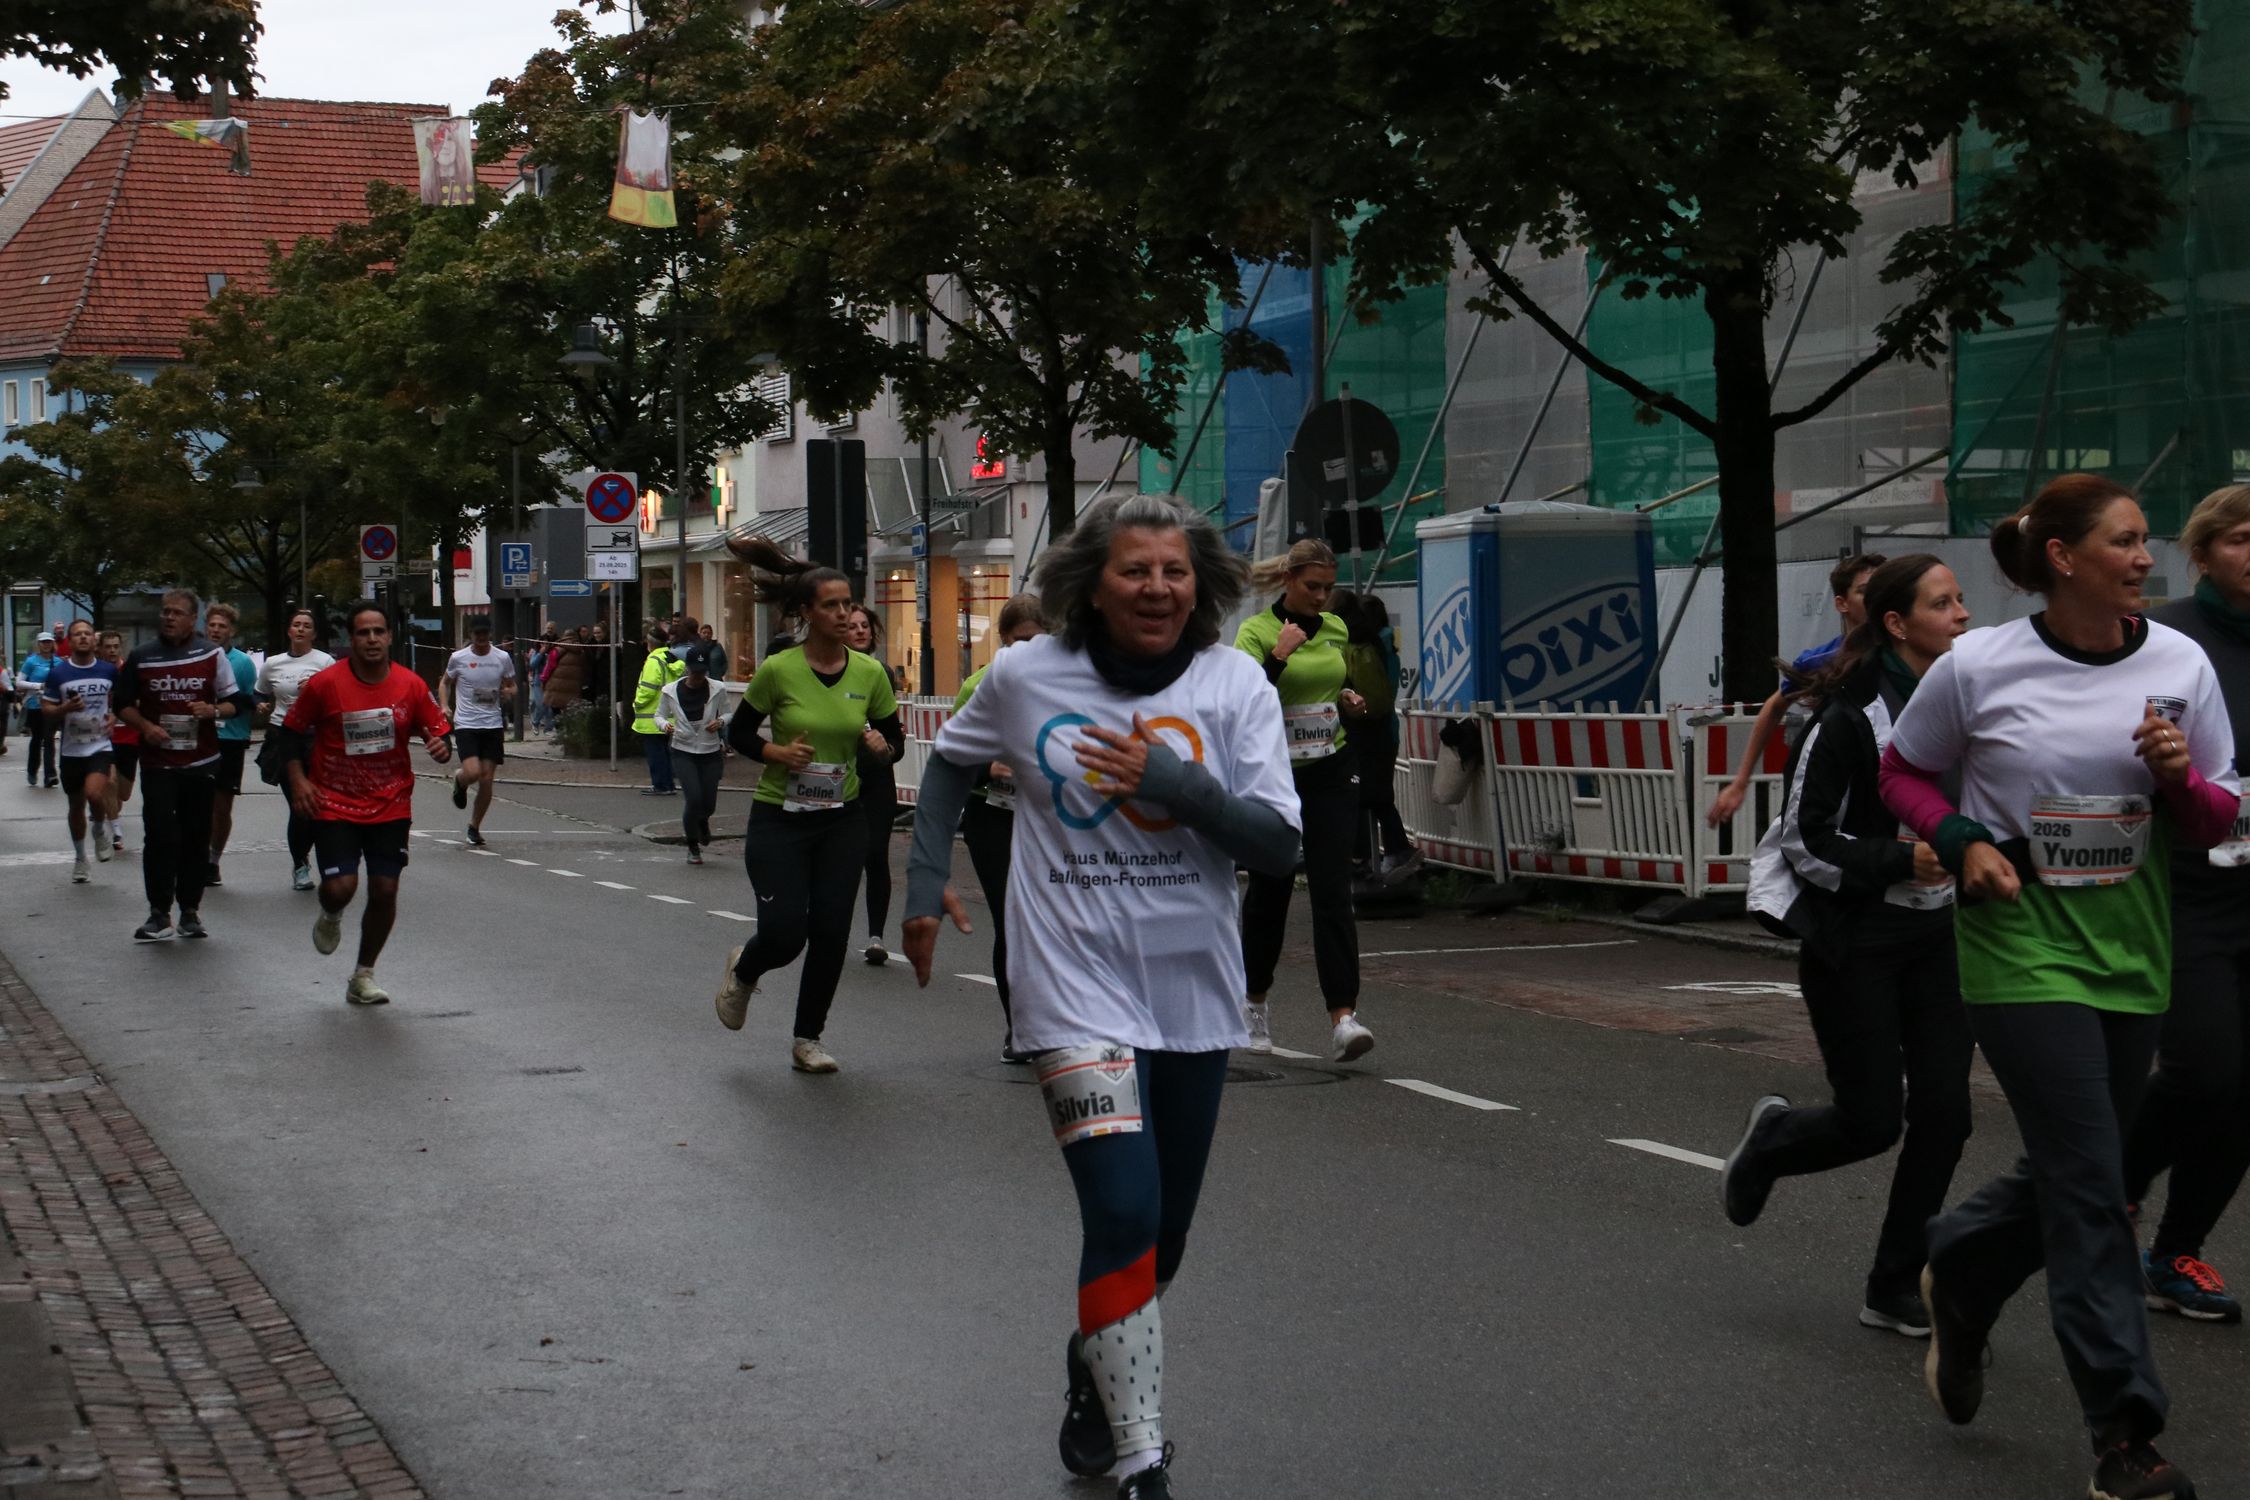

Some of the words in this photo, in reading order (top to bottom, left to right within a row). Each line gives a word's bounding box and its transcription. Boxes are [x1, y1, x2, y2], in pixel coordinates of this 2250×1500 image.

[508, 547, 525, 570] P
[150, 674, 206, 691] schwer
[347, 726, 390, 741] Youssef
[1294, 727, 1331, 740] Elwira
[797, 784, 835, 799] Celine
[2032, 821, 2072, 837] 2026
[1104, 850, 1183, 866] Münzehof
[2043, 842, 2134, 867] Yvonne
[1055, 1091, 1115, 1125] Silvia
